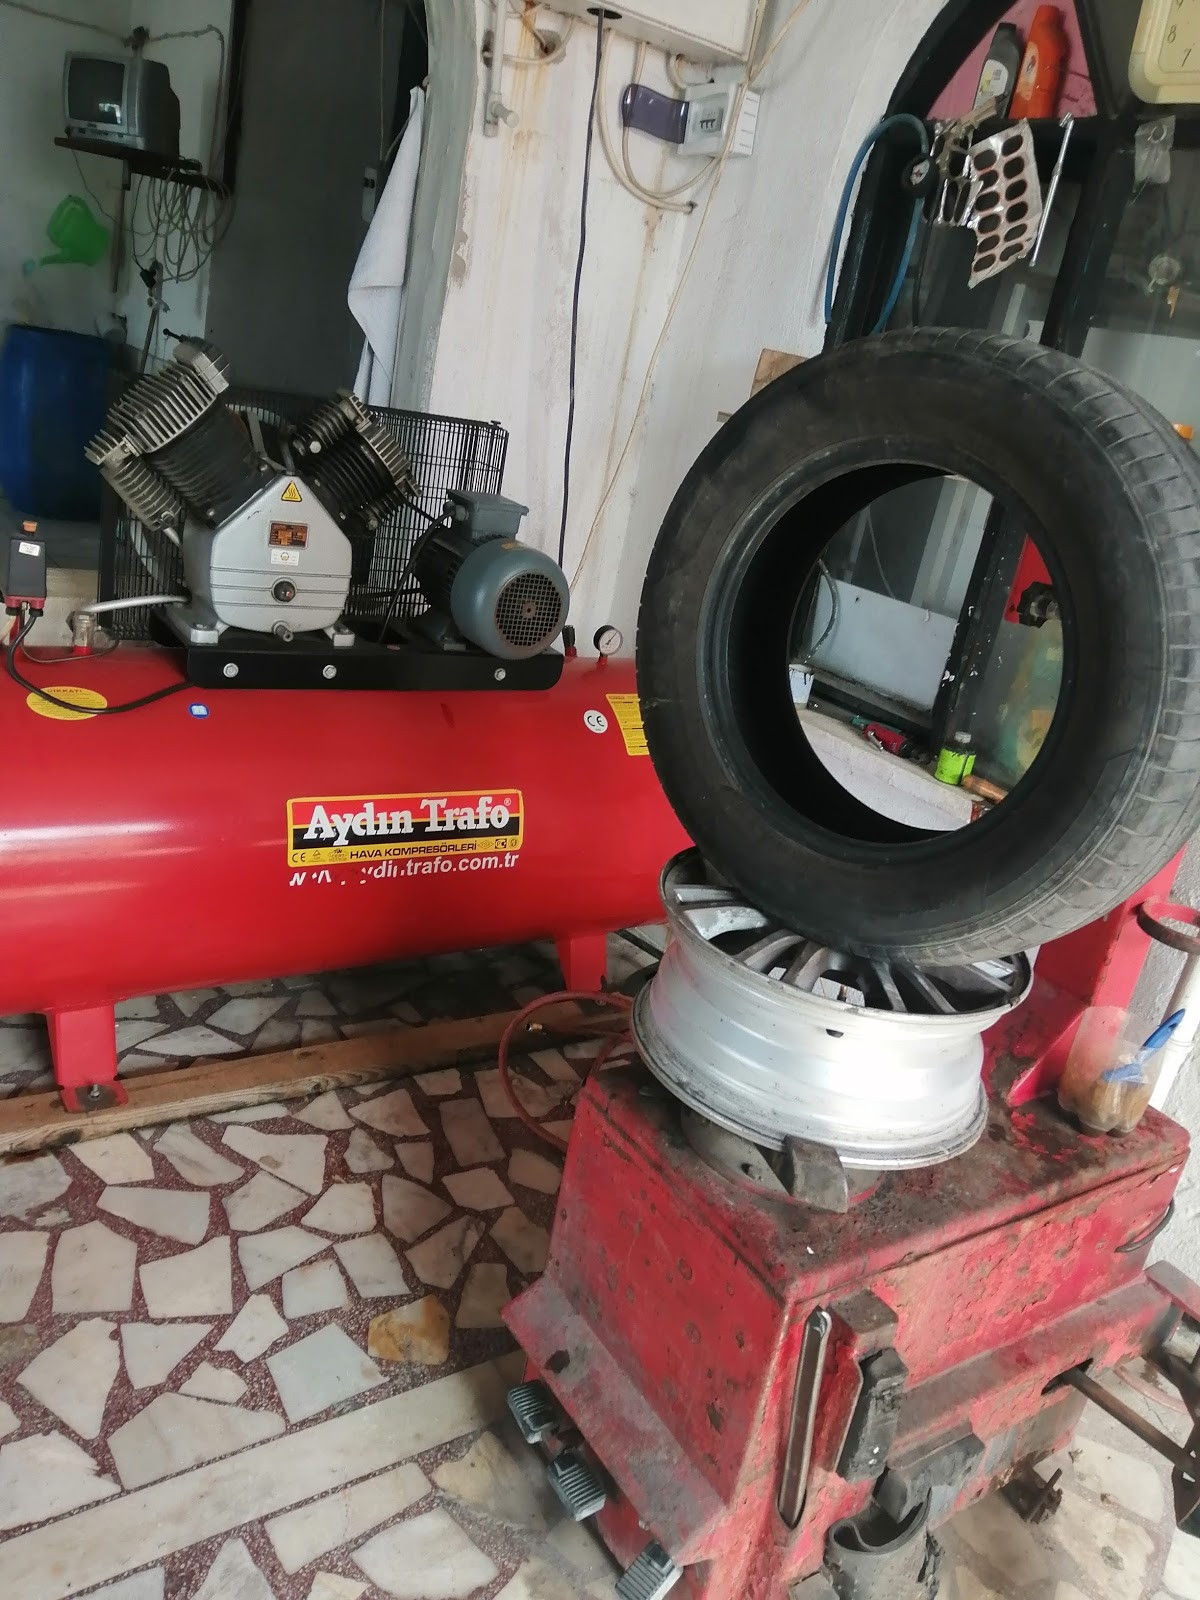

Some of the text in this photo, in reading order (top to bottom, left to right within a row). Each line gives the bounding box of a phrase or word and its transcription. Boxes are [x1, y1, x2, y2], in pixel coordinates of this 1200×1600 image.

[1167, 24, 1177, 44] 8
[1181, 48, 1192, 68] 7
[303, 797, 510, 846] Aydın Trafo
[350, 849, 383, 860] HAVA
[385, 840, 477, 857] KOMPRESÖRLERİ
